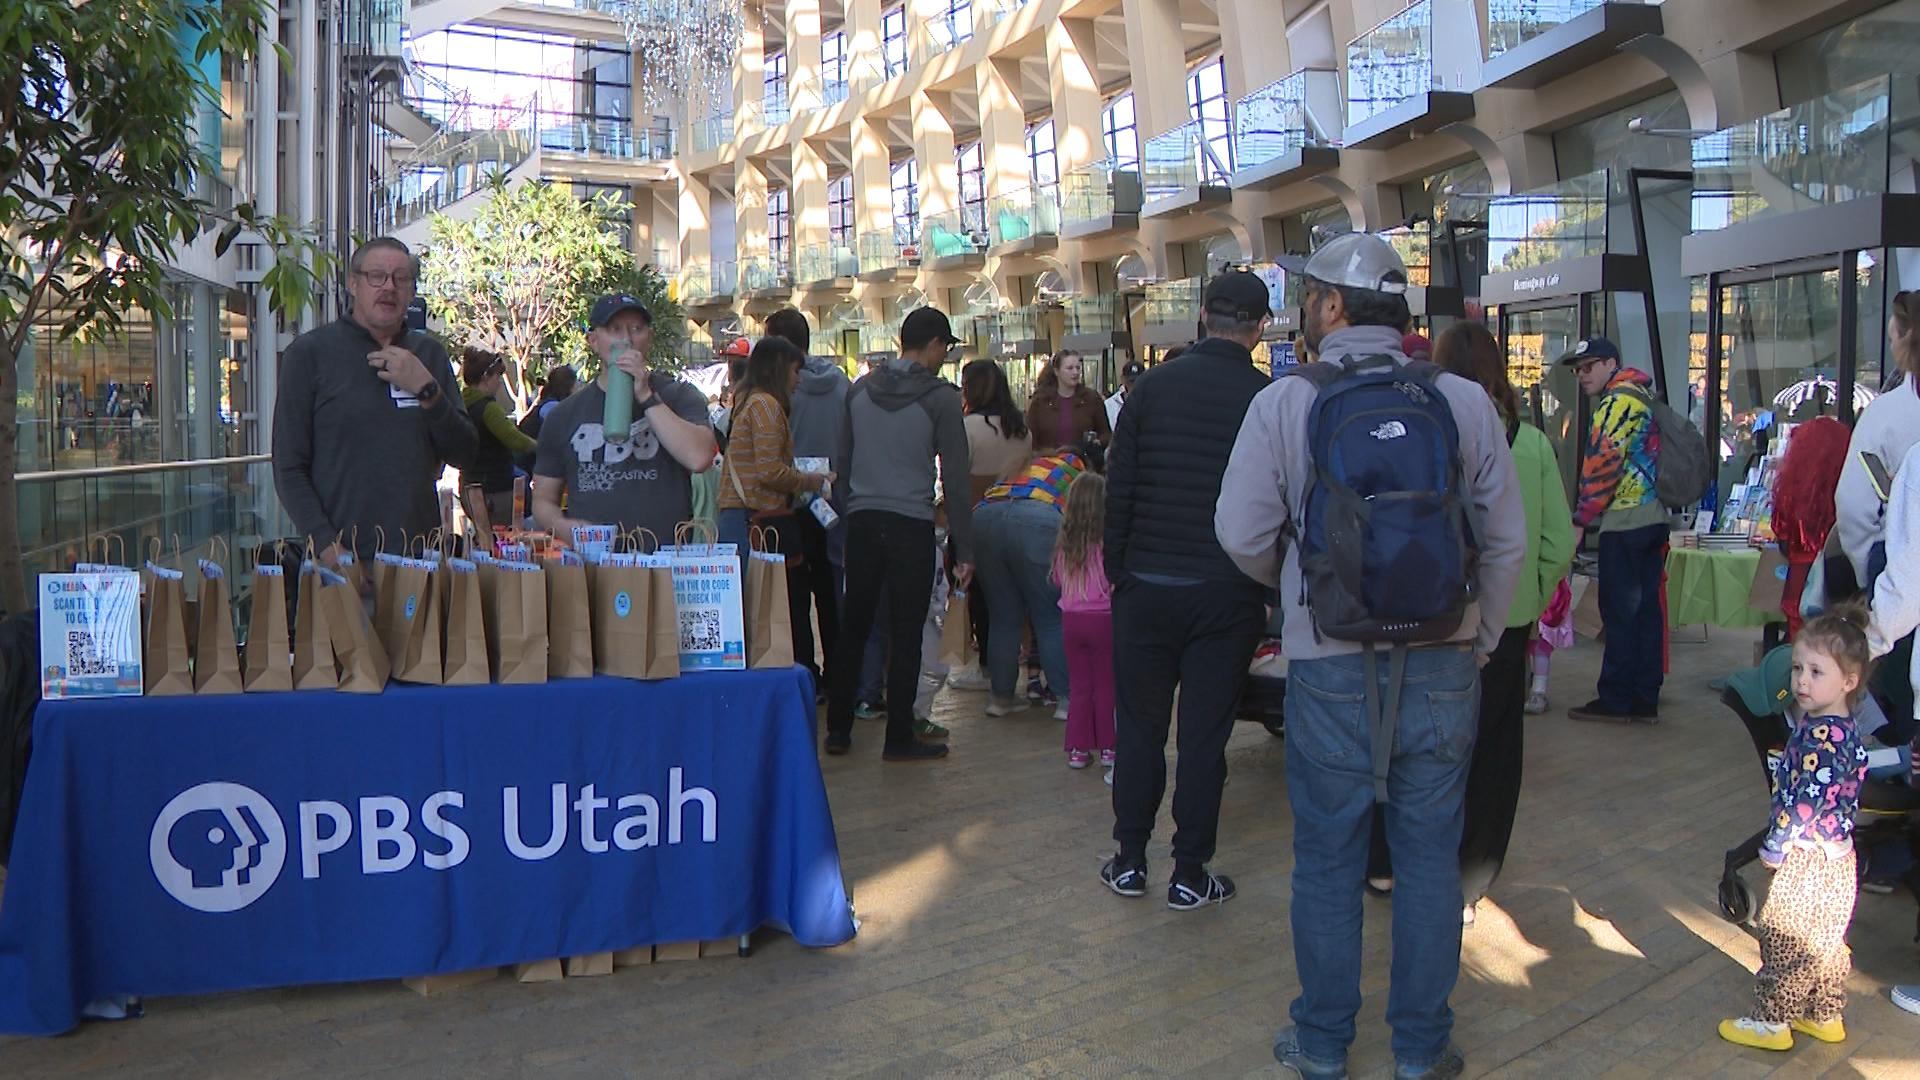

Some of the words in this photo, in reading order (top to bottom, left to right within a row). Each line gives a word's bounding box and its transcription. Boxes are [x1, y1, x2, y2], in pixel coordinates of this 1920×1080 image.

[687, 579, 699, 592] THE
[700, 579, 711, 592] QR
[711, 579, 730, 590] CODE
[53, 597, 75, 610] SCAN
[687, 593, 710, 604] CHECK
[66, 612, 75, 623] TO
[298, 791, 472, 879] PBS
[502, 766, 719, 861] Utah
